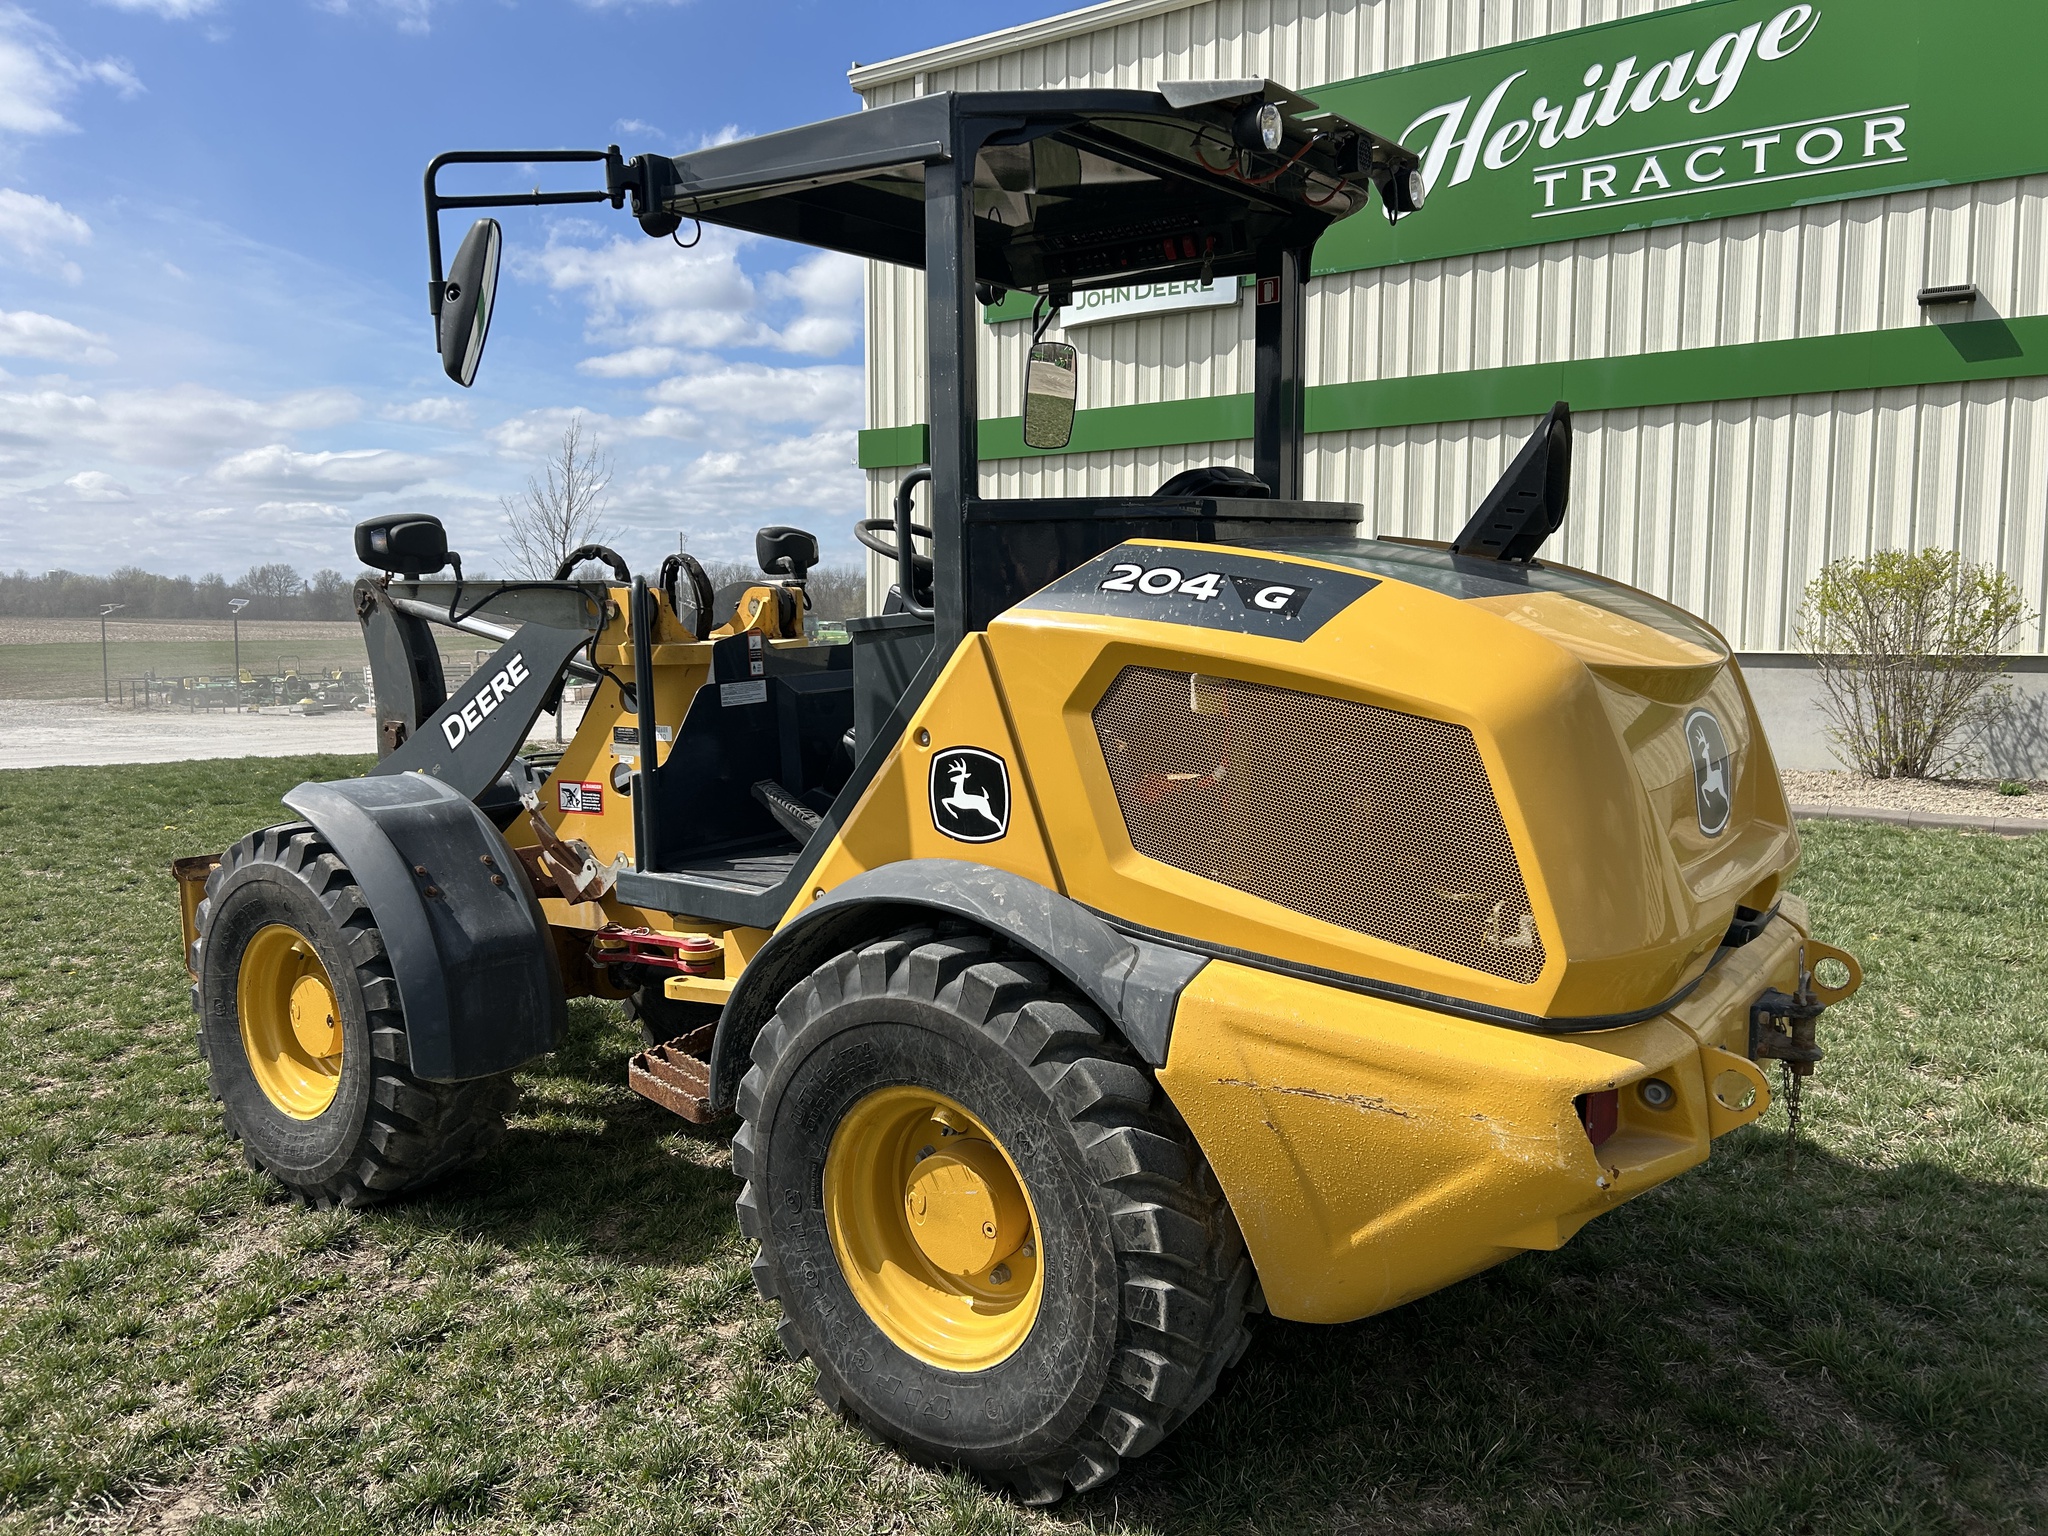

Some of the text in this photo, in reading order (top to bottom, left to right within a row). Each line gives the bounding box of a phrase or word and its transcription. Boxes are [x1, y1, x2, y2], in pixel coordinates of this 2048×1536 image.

[1382, 2, 1822, 220] Heritage
[1532, 116, 1908, 207] TRACTOR
[1076, 286, 1130, 310] JOHN
[1101, 564, 1296, 609] 204 G
[441, 653, 530, 750] DEERE
[790, 1041, 872, 1125] UTILITY
